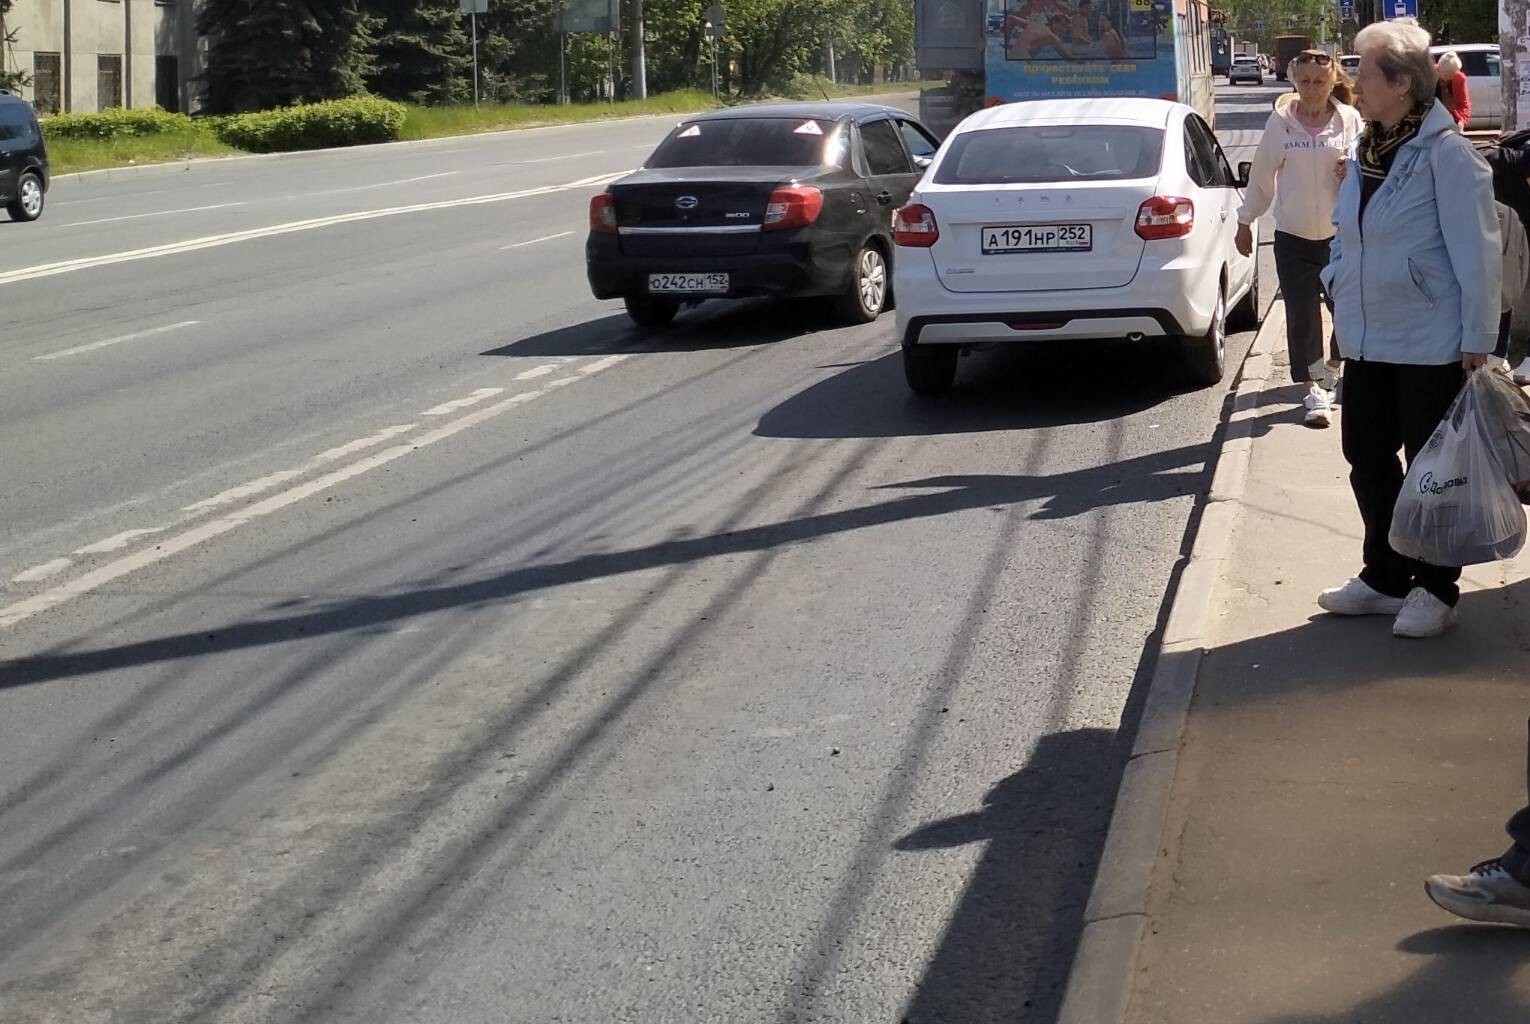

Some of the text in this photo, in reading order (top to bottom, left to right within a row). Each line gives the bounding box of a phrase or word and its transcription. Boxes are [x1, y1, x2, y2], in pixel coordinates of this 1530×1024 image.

[989, 226, 1086, 247] А191НР 252
[652, 274, 725, 289] О242СН 152
